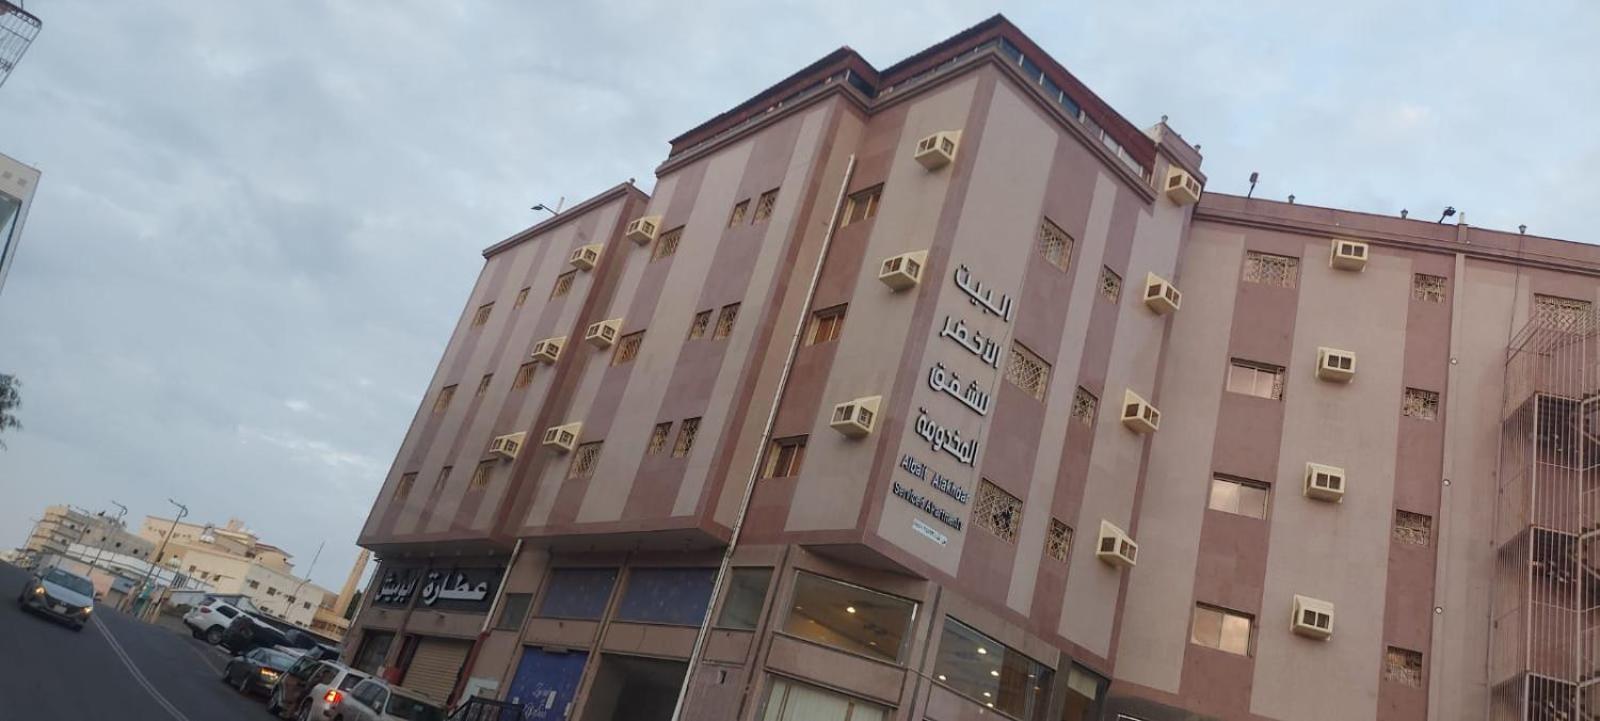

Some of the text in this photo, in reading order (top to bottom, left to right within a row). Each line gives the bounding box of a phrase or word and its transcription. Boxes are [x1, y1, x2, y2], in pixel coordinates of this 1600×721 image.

[954, 264, 1012, 322] البيت
[928, 362, 990, 416] للشقق
[915, 407, 979, 467] المخدومة
[900, 453, 928, 481] Albait
[422, 572, 488, 605] عطارة
